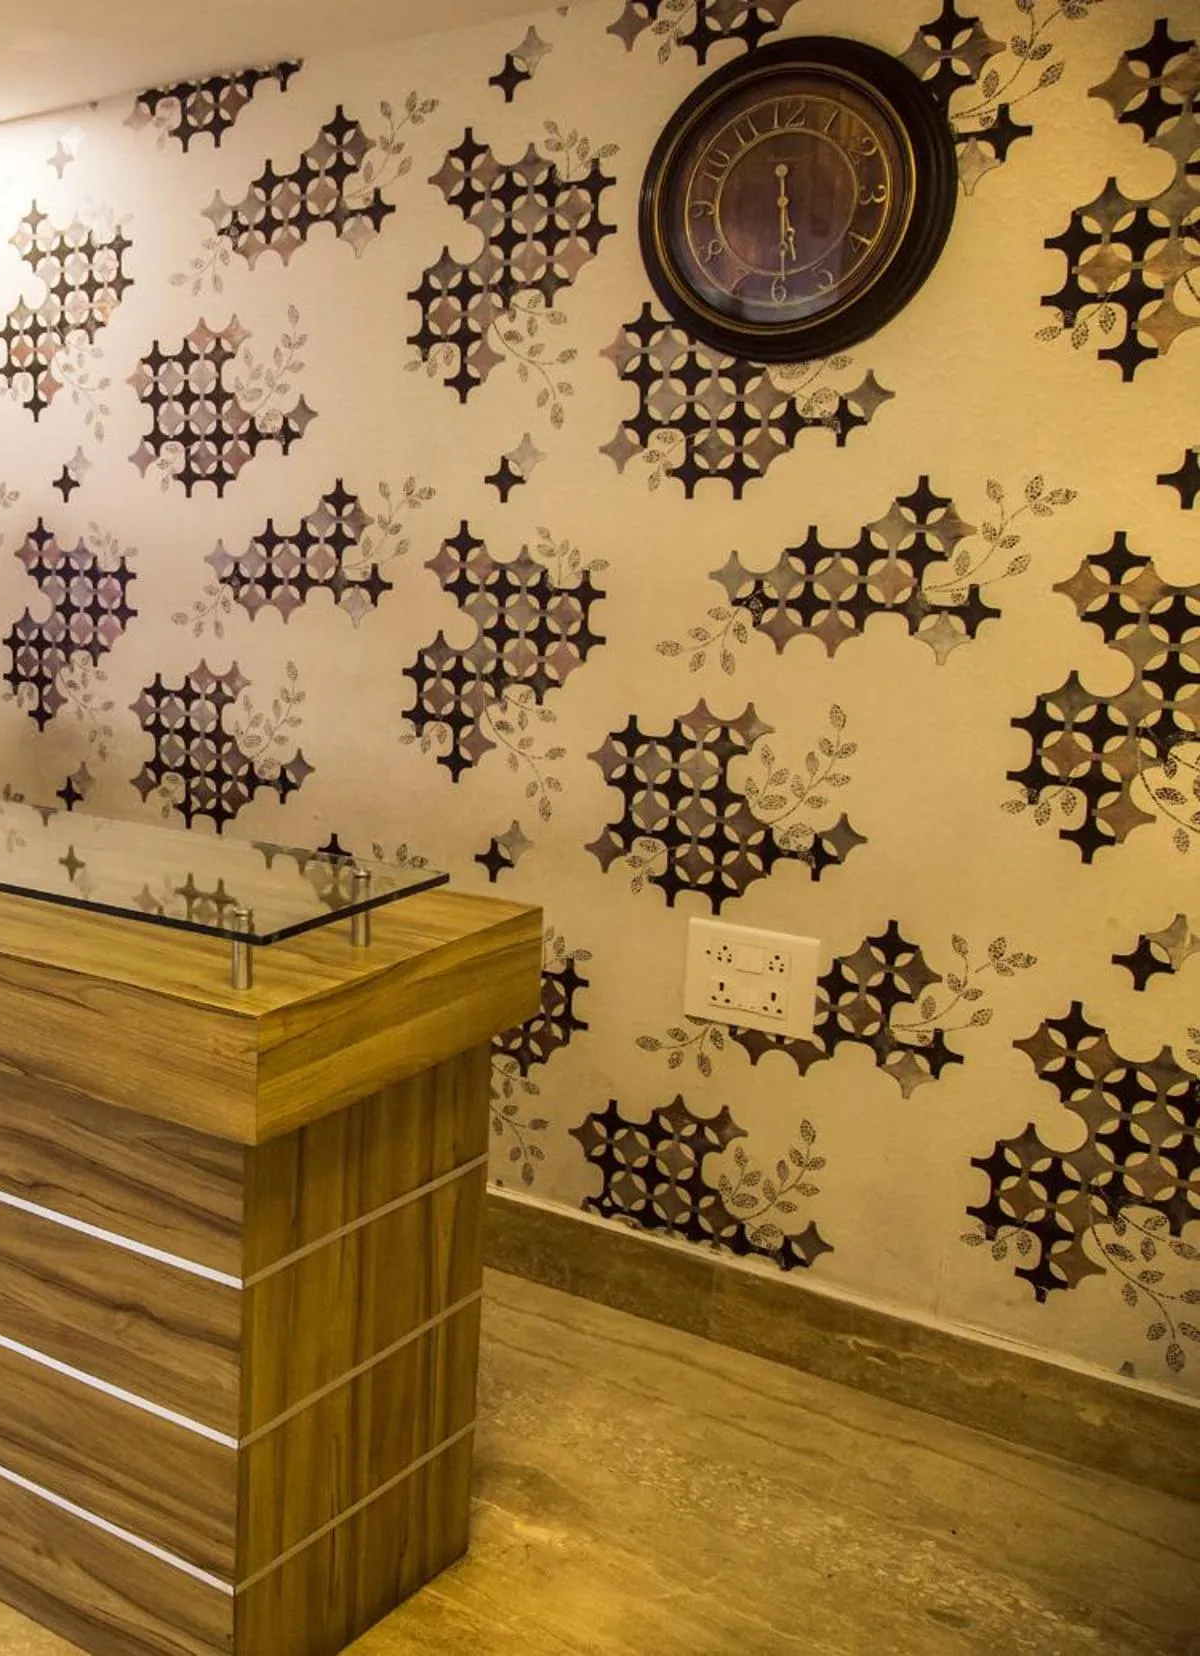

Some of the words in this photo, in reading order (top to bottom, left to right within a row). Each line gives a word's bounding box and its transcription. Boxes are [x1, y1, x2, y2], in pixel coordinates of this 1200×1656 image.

[771, 101, 807, 129] 12
[823, 107, 840, 134] 1
[731, 113, 760, 147] 11
[700, 146, 731, 182] 10
[847, 136, 878, 165] 2
[860, 184, 888, 206] 3
[689, 200, 716, 219] 9
[696, 238, 723, 264] 8
[846, 230, 874, 255] 4
[811, 259, 835, 291] 5
[771, 276, 787, 303] 6
